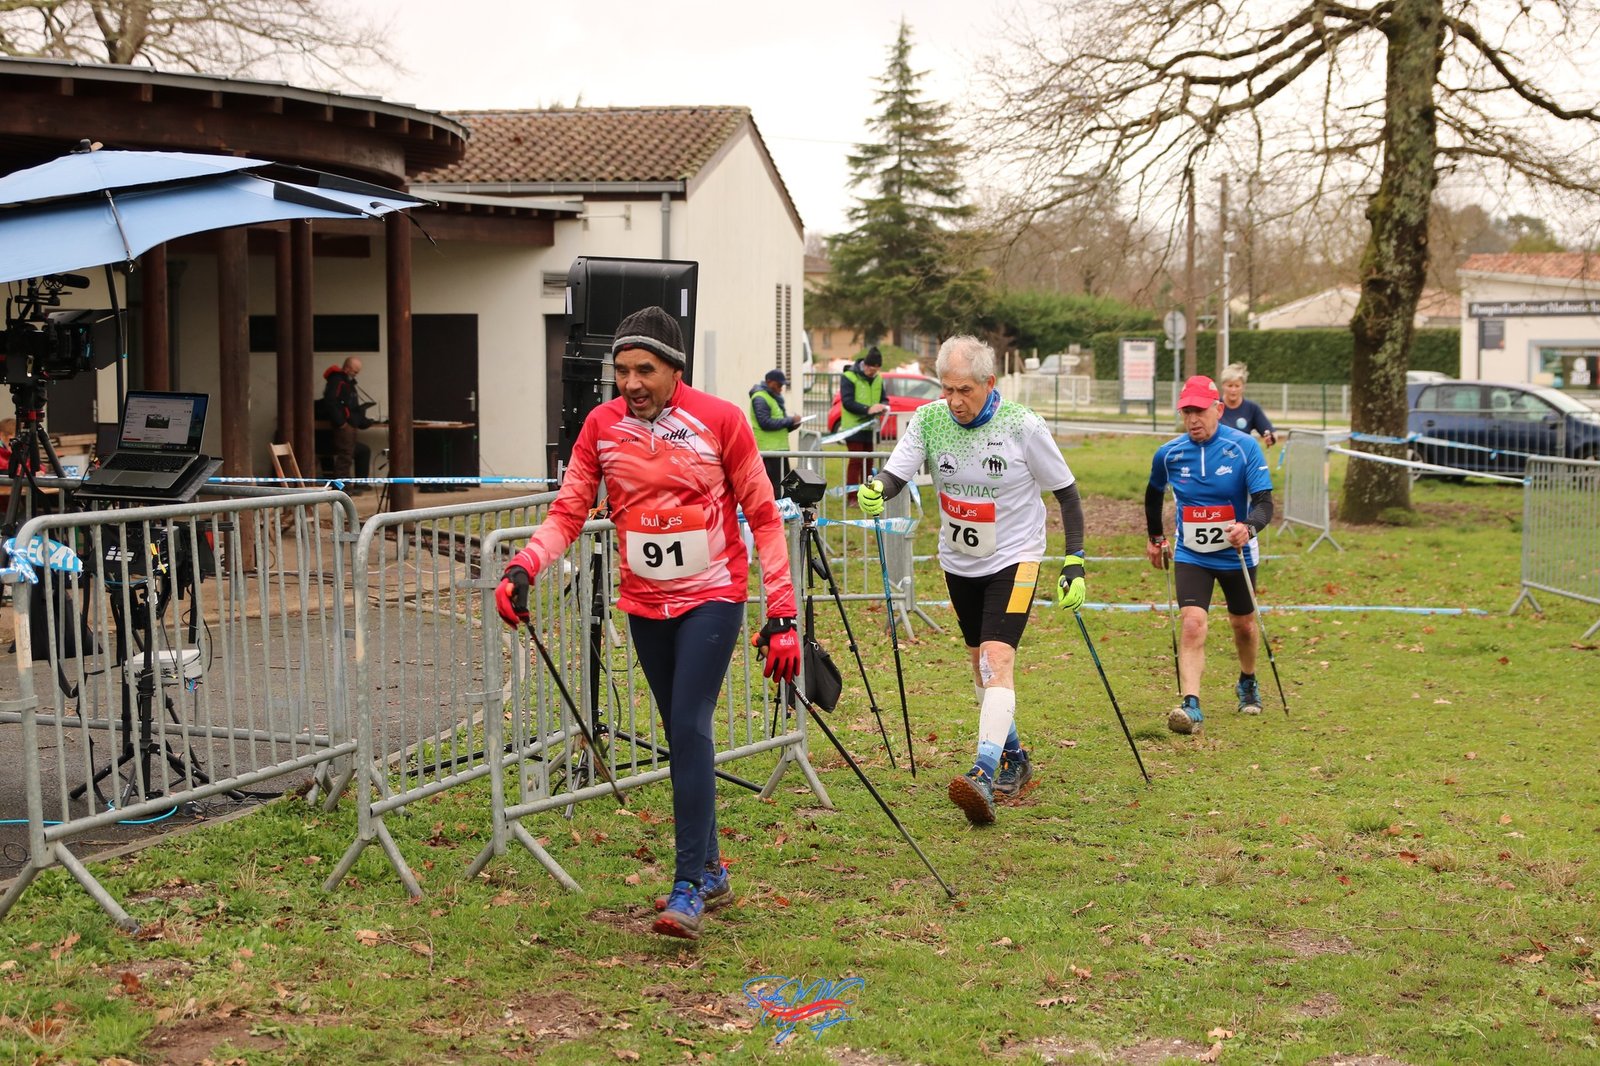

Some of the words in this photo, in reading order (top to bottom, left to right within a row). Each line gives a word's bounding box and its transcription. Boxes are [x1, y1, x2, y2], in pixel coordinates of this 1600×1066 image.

[943, 482, 1000, 499] ESVMAC
[948, 521, 979, 547] 76
[1194, 527, 1225, 545] 52
[642, 540, 684, 568] 91
